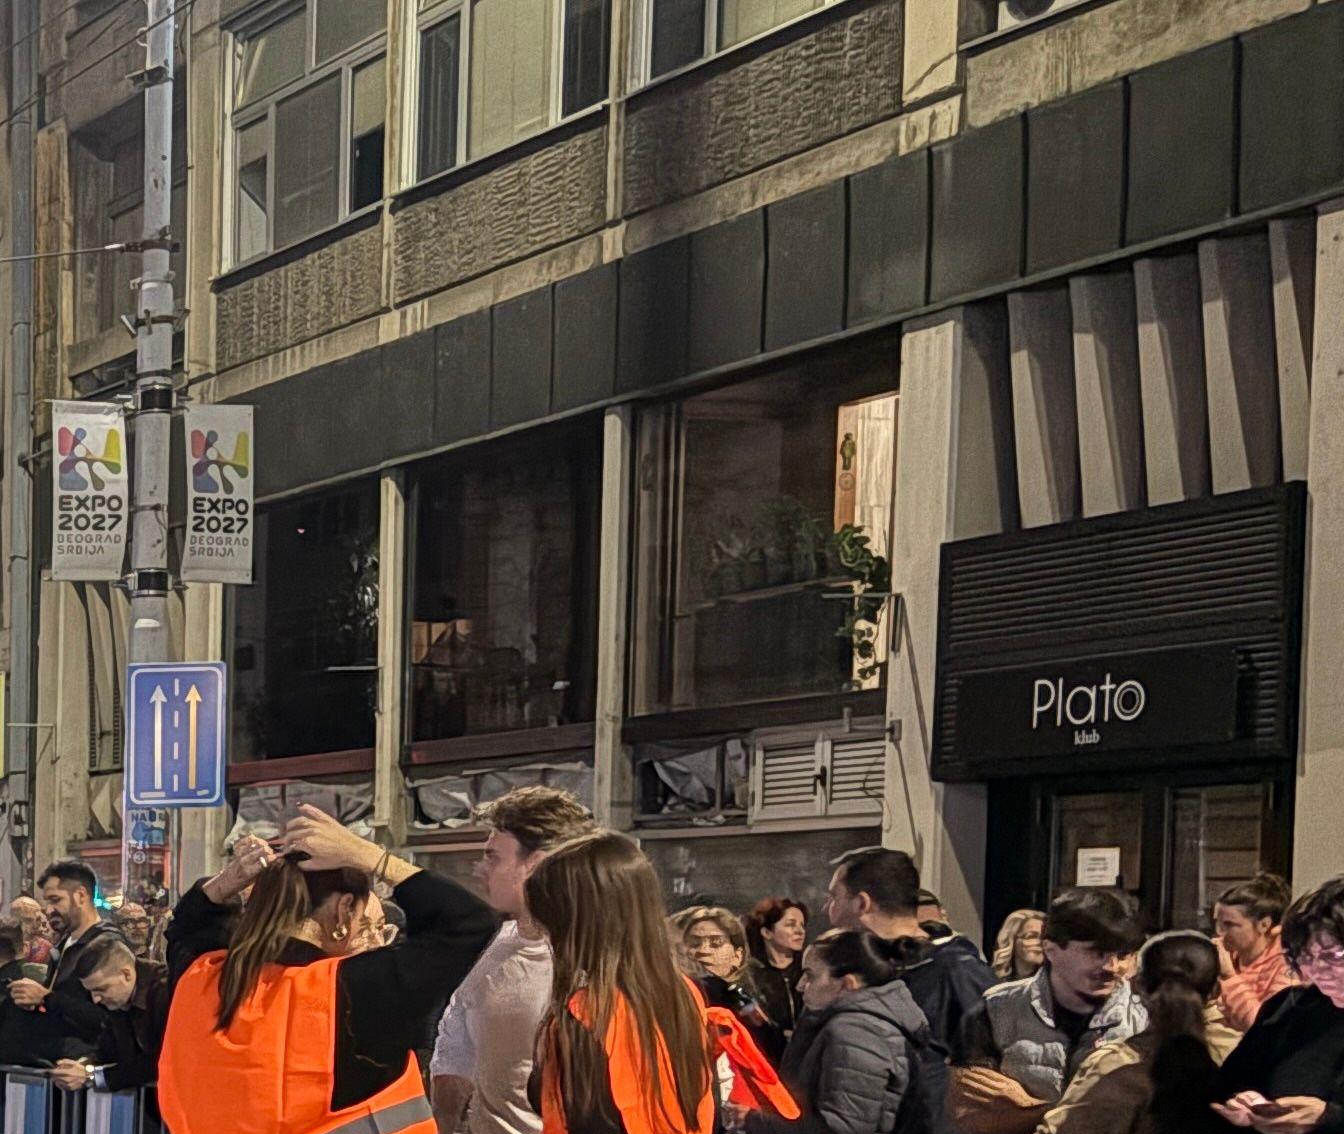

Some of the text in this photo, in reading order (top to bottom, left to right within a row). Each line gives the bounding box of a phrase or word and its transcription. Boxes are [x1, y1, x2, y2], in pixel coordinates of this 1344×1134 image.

[58, 495, 123, 512] EXPO
[192, 496, 249, 515] EXPO
[58, 514, 123, 531] 2027
[192, 516, 249, 534] 2027
[1032, 672, 1145, 729] Plato
[1074, 728, 1100, 745] klub
